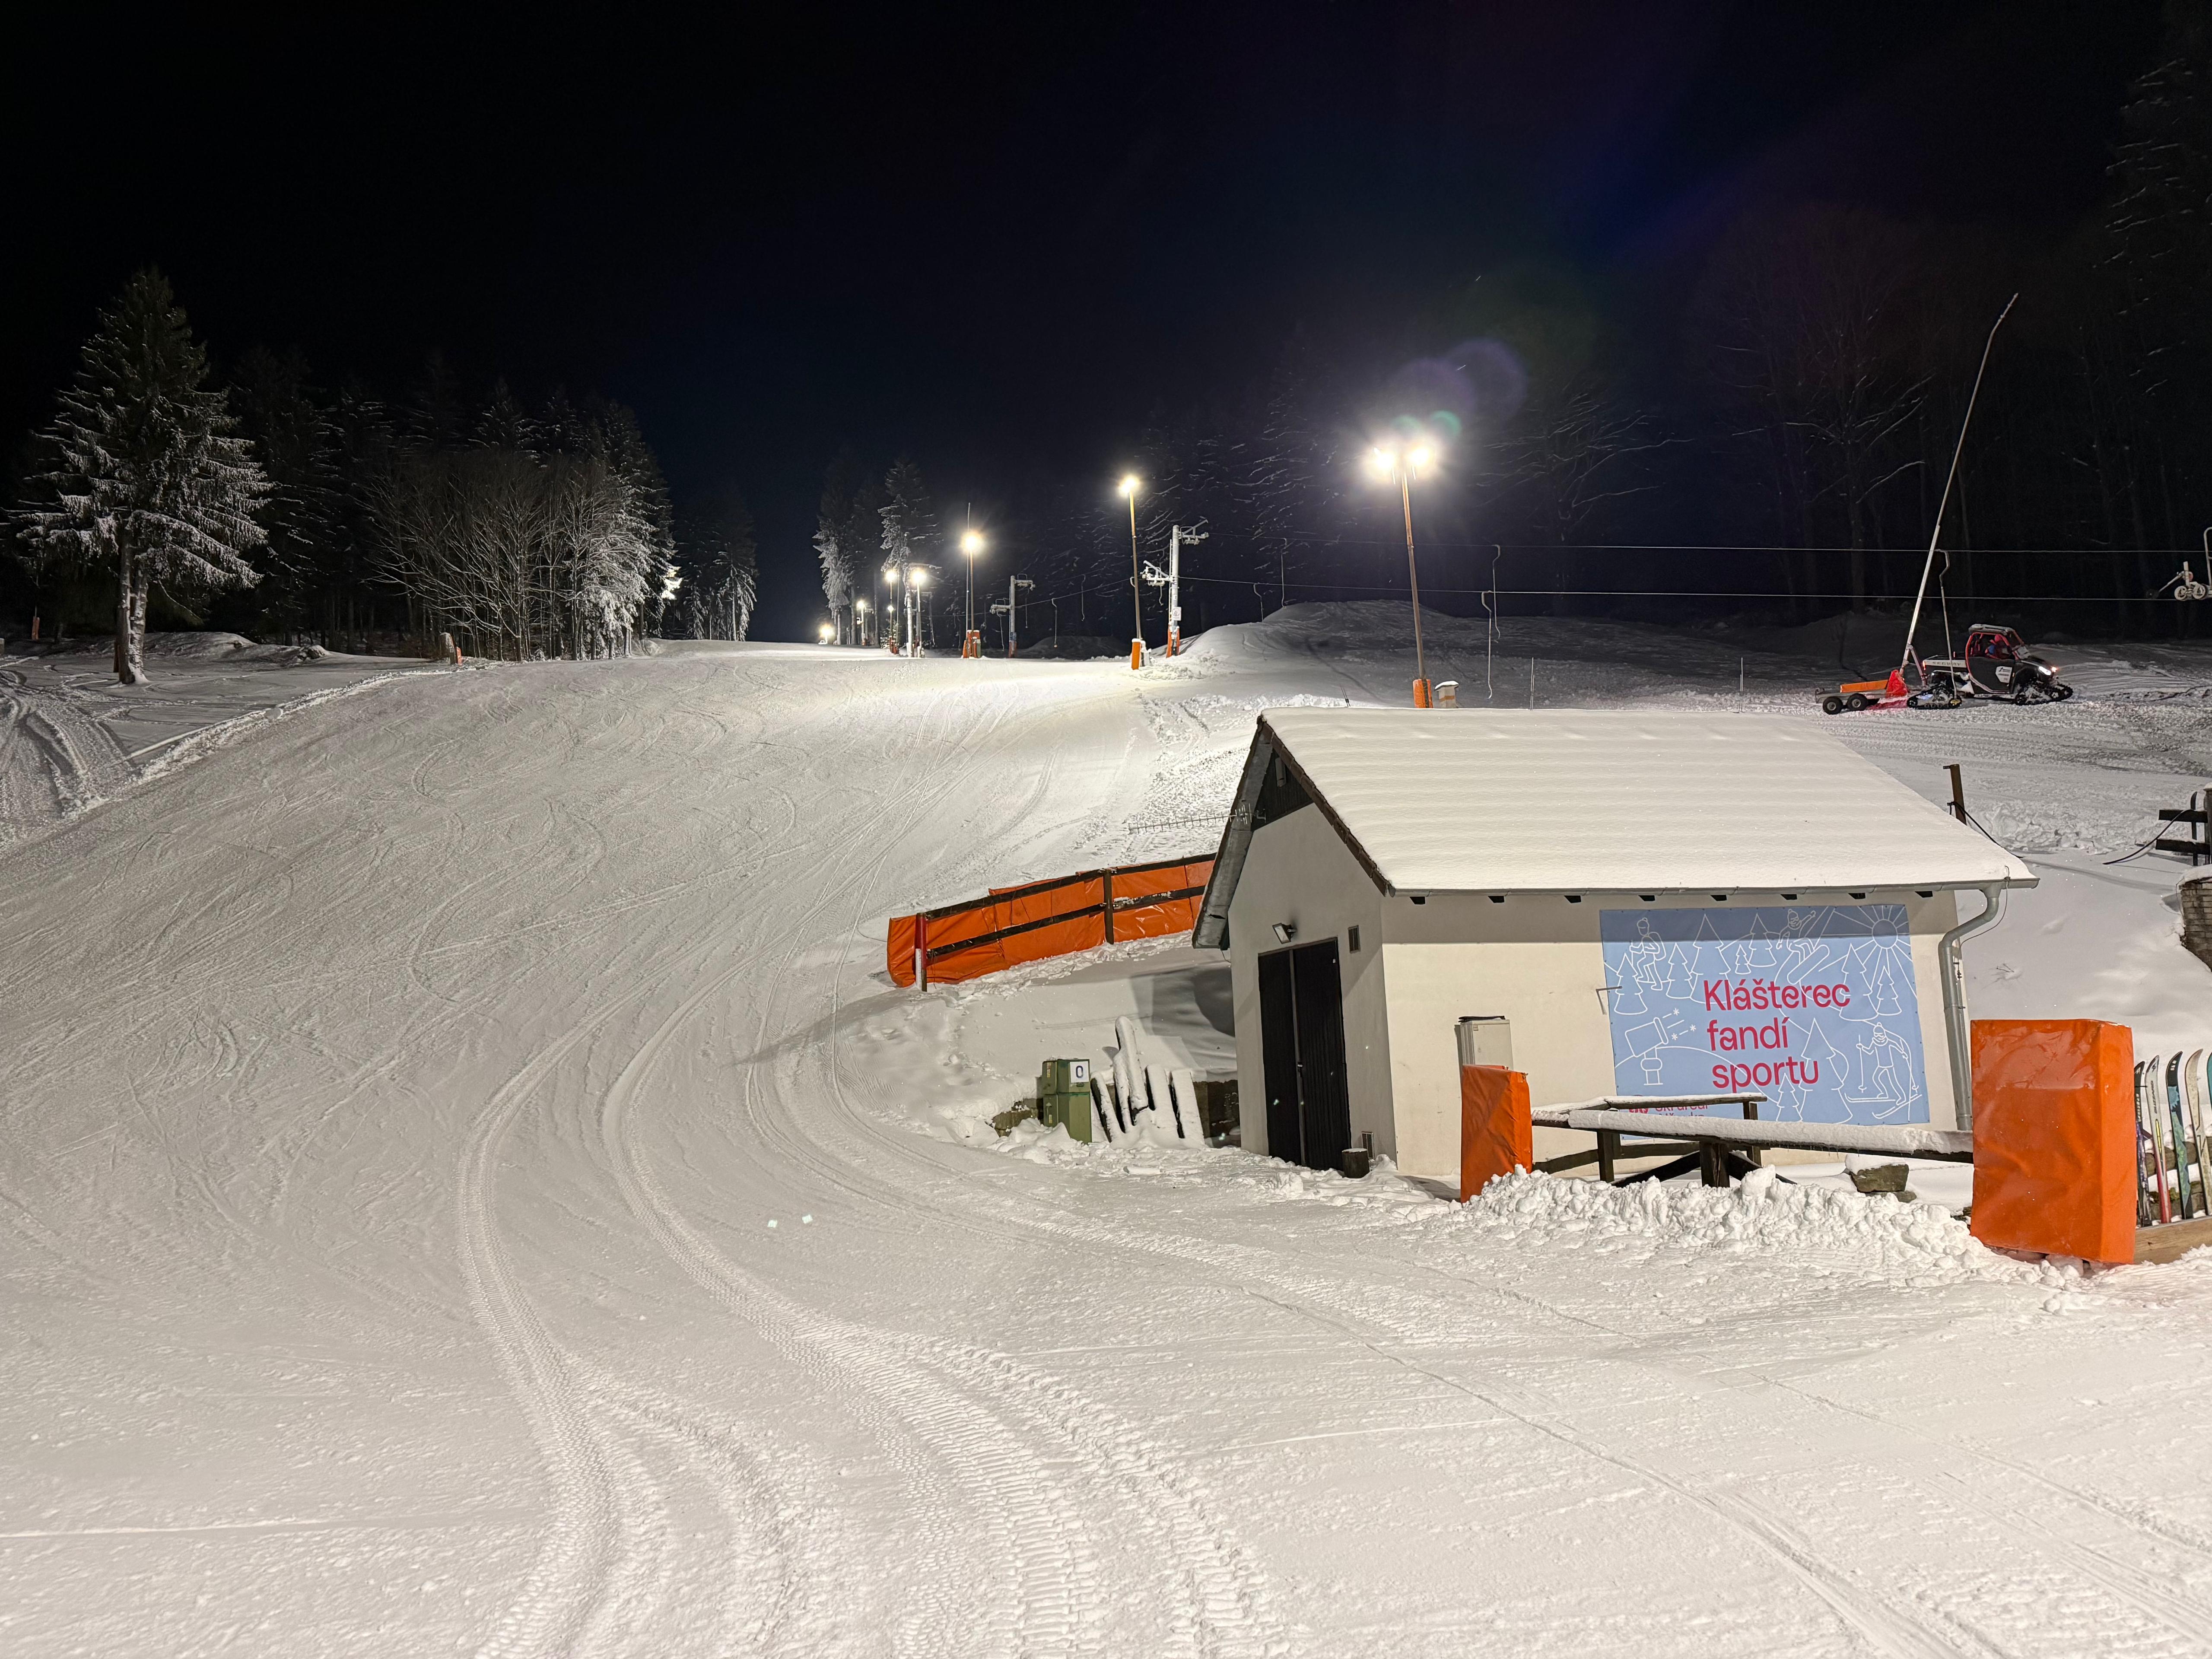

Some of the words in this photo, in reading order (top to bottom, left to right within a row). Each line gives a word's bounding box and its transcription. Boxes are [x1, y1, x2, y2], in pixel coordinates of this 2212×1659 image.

[1704, 979, 1850, 1011] Klášterec
[1707, 1017, 1789, 1051] fandí
[1712, 1057, 1818, 1093] sportu
